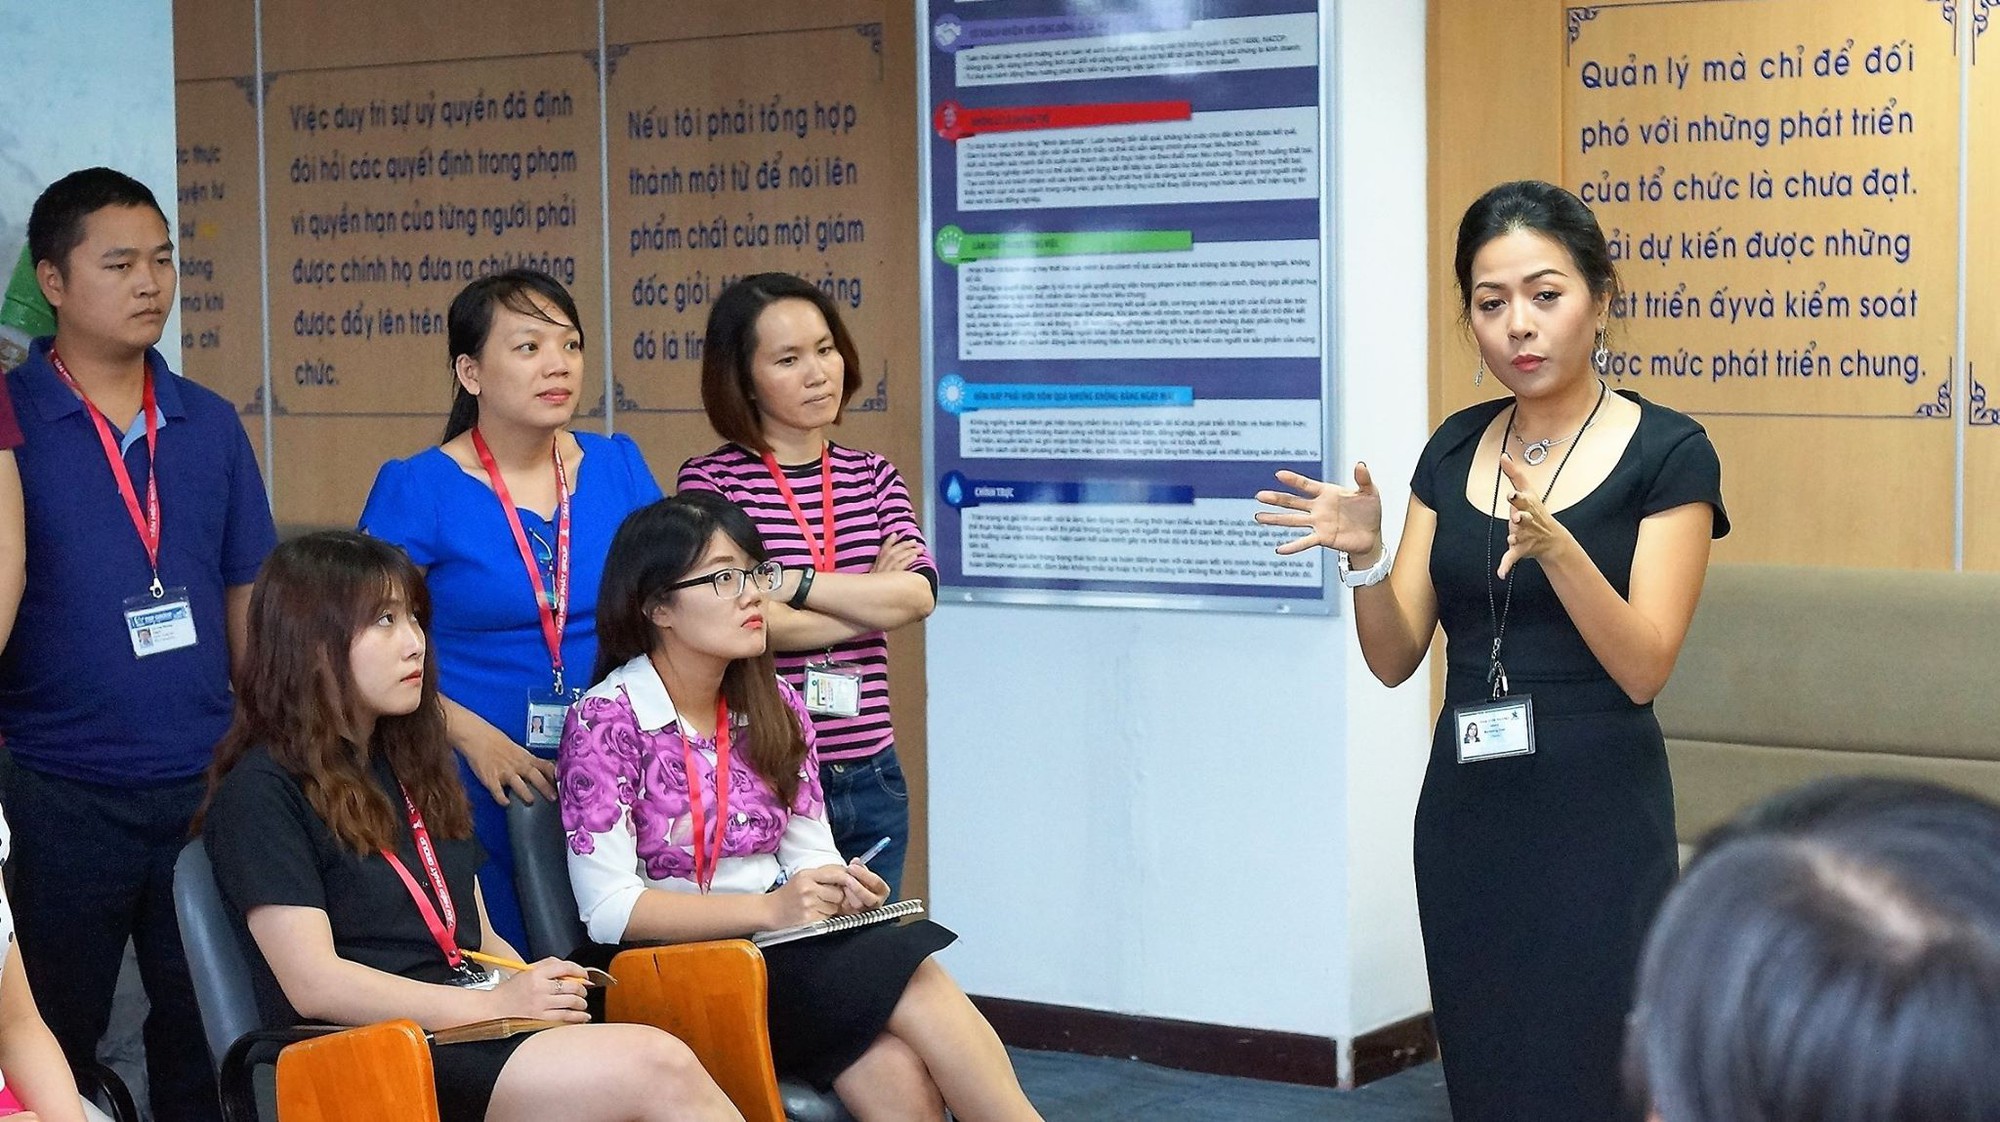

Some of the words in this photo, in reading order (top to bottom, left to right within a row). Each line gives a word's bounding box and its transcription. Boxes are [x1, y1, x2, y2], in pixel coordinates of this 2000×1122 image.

[1581, 52, 1657, 90] Quản
[1667, 54, 1690, 90] lý
[1703, 52, 1746, 83] mà
[1760, 44, 1805, 80] chỉ
[1813, 38, 1855, 77] để
[1865, 39, 1914, 74] đối
[290, 101, 329, 136] Việc
[333, 102, 365, 134] duy
[391, 100, 411, 132] sự
[441, 88, 498, 128] quyền
[534, 90, 573, 124] định
[628, 105, 668, 139] Nếu
[675, 107, 701, 137] tôi
[707, 99, 754, 141] phải
[759, 93, 808, 138] tổng
[814, 100, 857, 136] hợp
[1581, 118, 1630, 153] phó
[1640, 116, 1679, 145] với
[1688, 112, 1770, 147] những
[1780, 107, 1843, 145] phát
[1851, 97, 1914, 136] triển
[320, 149, 346, 182] hỏi
[350, 152, 382, 180] các
[386, 146, 433, 184] quyết
[438, 149, 473, 181] định
[478, 150, 521, 181] trong
[526, 145, 577, 180] phạm
[629, 165, 683, 195] thành
[688, 163, 725, 199] một
[731, 159, 750, 191] từ
[756, 151, 783, 190] để
[788, 153, 821, 188] nói
[825, 155, 858, 186] lên
[1581, 170, 1631, 203] của
[1639, 165, 1665, 202] tổ
[1673, 170, 1740, 201] chức
[1750, 170, 1773, 200] là
[1785, 170, 1853, 199] chưa
[1863, 167, 1918, 203] đạt.
[309, 201, 360, 241] quyền
[364, 207, 396, 239] hạn
[401, 199, 434, 232] của
[482, 199, 531, 237] người
[536, 192, 577, 232] phải
[630, 213, 682, 257] phẩm
[687, 216, 728, 249] chất
[733, 211, 769, 247] của
[774, 214, 810, 252] một
[816, 211, 865, 252] giám
[1606, 228, 1631, 262] ải
[1639, 232, 1673, 267] dự
[1682, 226, 1737, 259] kiến
[1746, 229, 1815, 266] được
[1825, 226, 1911, 264] những
[292, 255, 335, 289] được
[340, 255, 386, 283] chính
[390, 254, 413, 288] họ
[418, 254, 452, 281] đưa
[456, 258, 473, 281] ra
[632, 273, 668, 306] đốc
[1611, 290, 1637, 318] át
[1645, 282, 1701, 318] triển
[1785, 280, 1850, 318] kiểm
[1859, 288, 1919, 318] soát
[293, 308, 335, 343] được
[341, 300, 373, 341] đẩy
[378, 308, 405, 337] lên
[633, 330, 657, 361] đó
[662, 330, 678, 362] là
[1651, 346, 1704, 378] mức
[1712, 346, 1770, 383] phát
[1776, 340, 1832, 378] triển
[1841, 349, 1927, 385] chung.
[294, 357, 340, 387] chức.
[418, 836, 434, 867] GROUP
